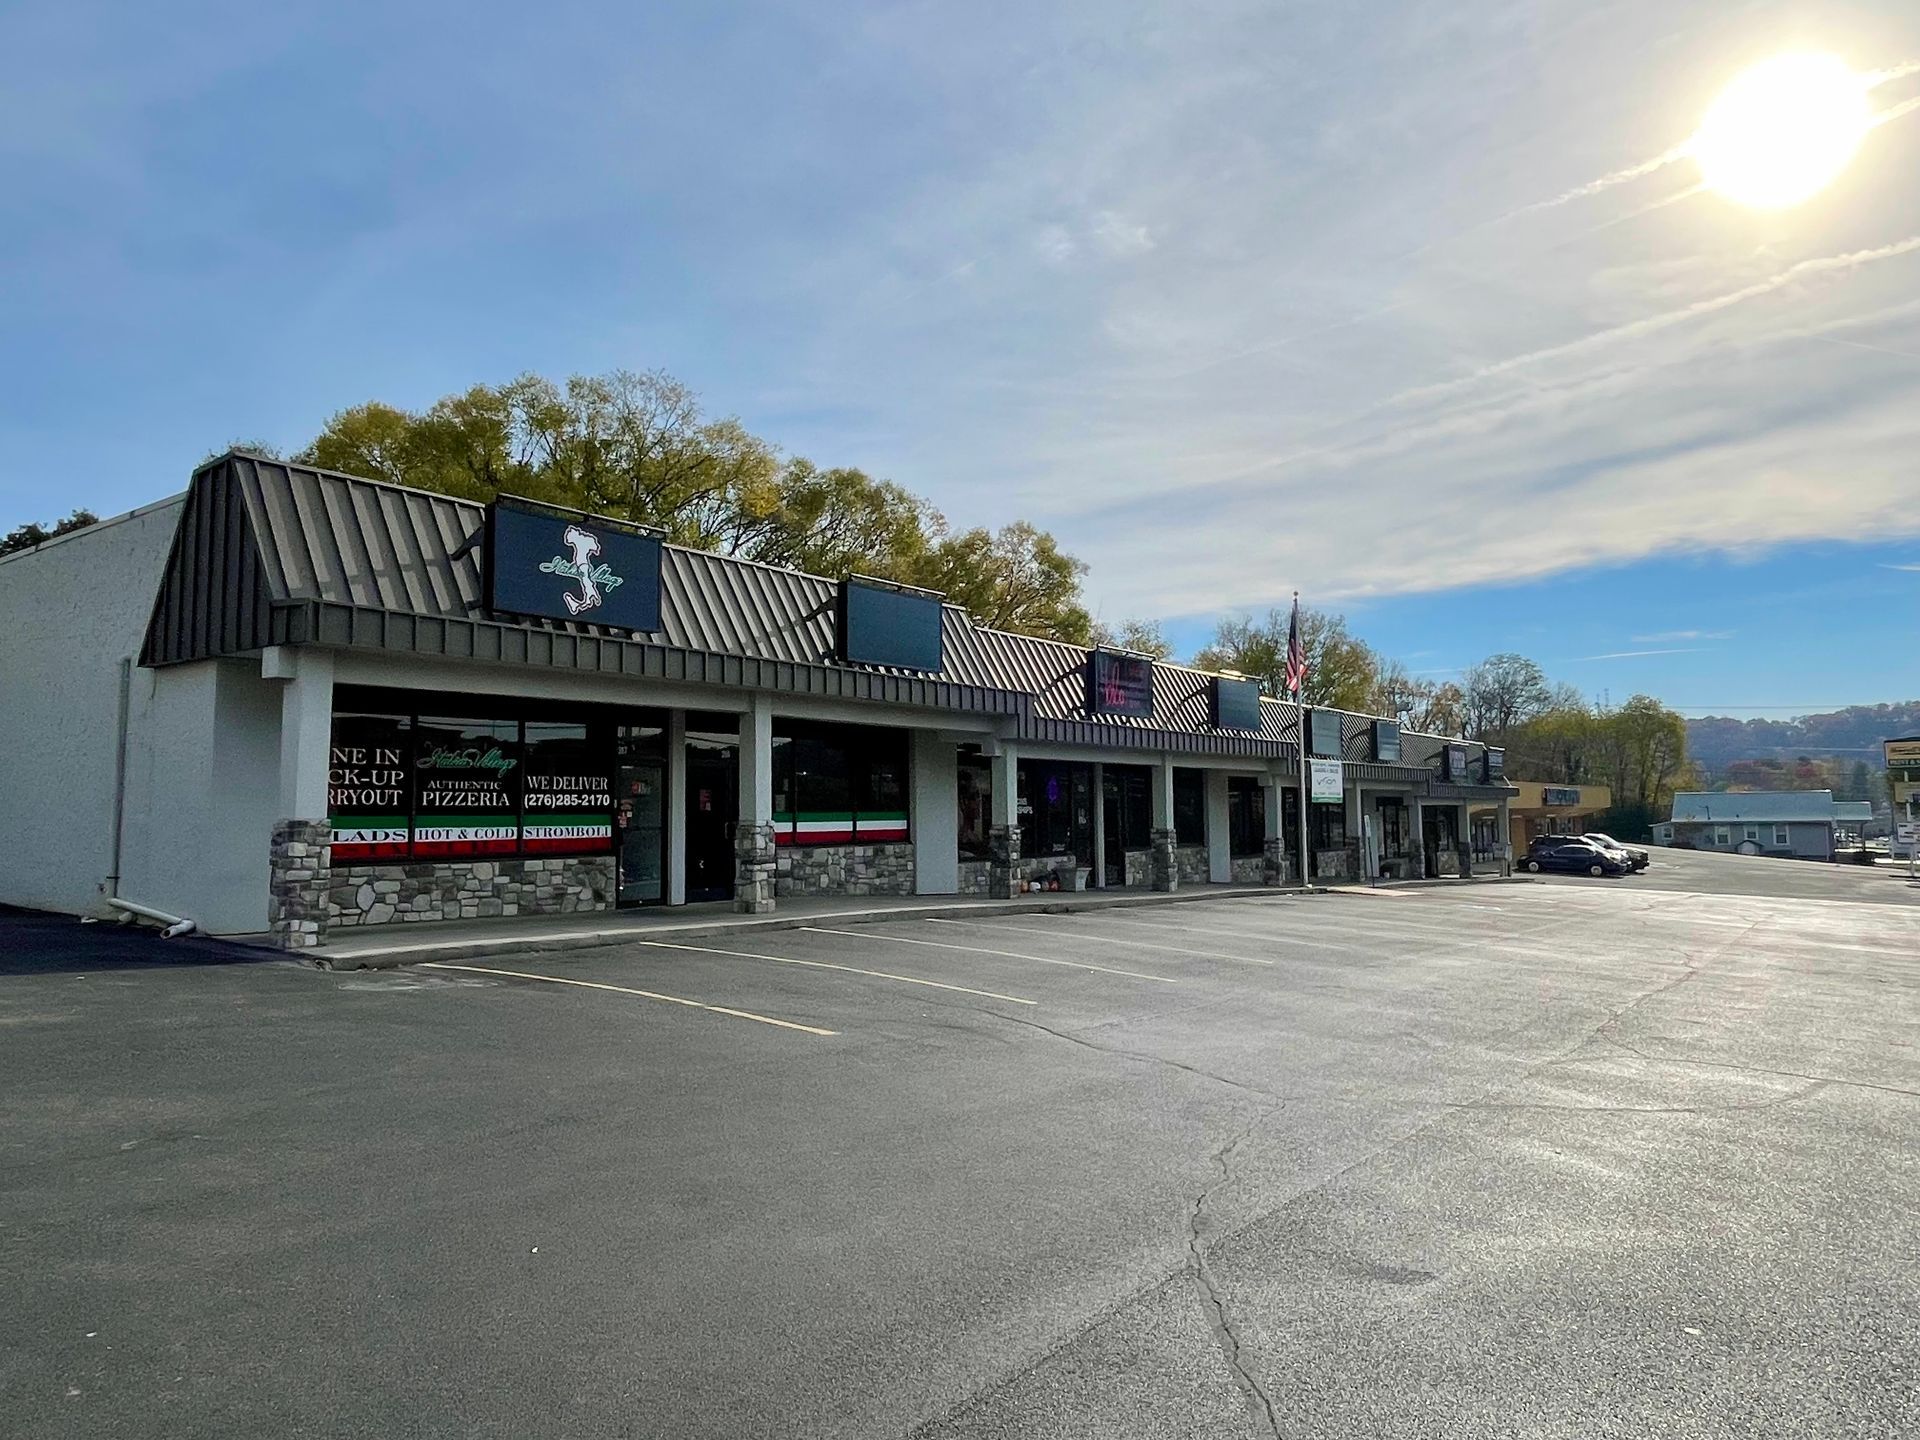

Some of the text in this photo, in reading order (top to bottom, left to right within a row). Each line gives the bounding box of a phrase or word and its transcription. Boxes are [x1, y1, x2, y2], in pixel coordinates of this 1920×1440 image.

[375, 748, 402, 765] IN
[328, 769, 404, 786] CK-UP
[527, 776, 608, 790] WE DELIVER
[427, 780, 502, 790] AUTHENTIC
[422, 791, 510, 806] PIZZERIA
[524, 794, 610, 809] (276)285-2170
[333, 830, 406, 842] LADS
[418, 828, 515, 840] HOT & COLD
[525, 825, 609, 838] STROMBOLI
